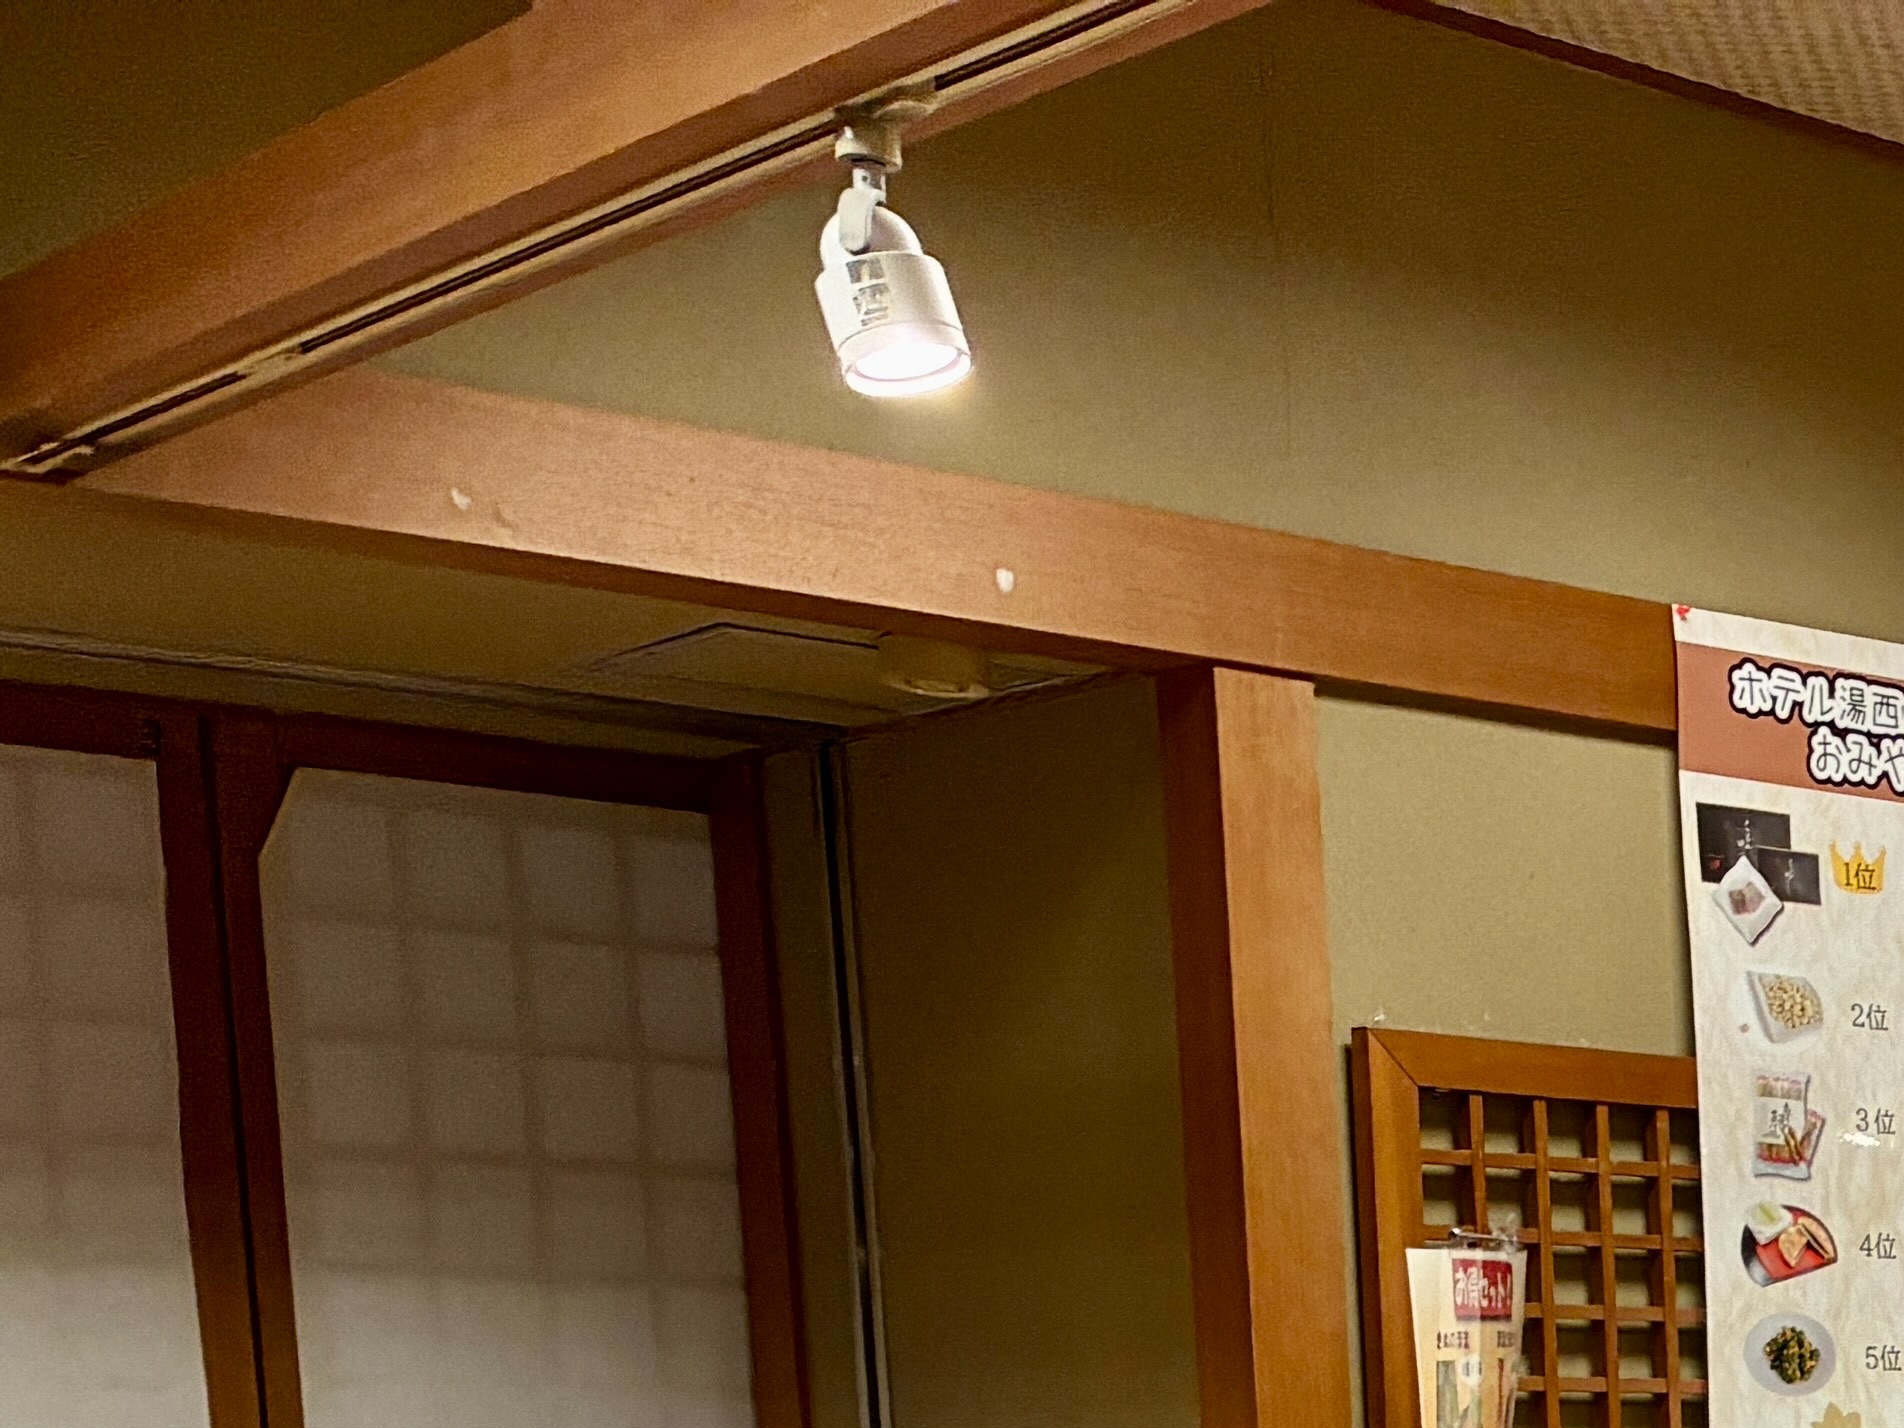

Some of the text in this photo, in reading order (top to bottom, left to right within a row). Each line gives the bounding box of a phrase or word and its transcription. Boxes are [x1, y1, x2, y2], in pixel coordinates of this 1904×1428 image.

[1842, 861, 1878, 893] 1位
[1851, 1003, 1889, 1032] 2位
[1855, 1107, 1896, 1136] 3位
[1859, 1231, 1897, 1260] 4位
[1864, 1344, 1902, 1373] 5位
